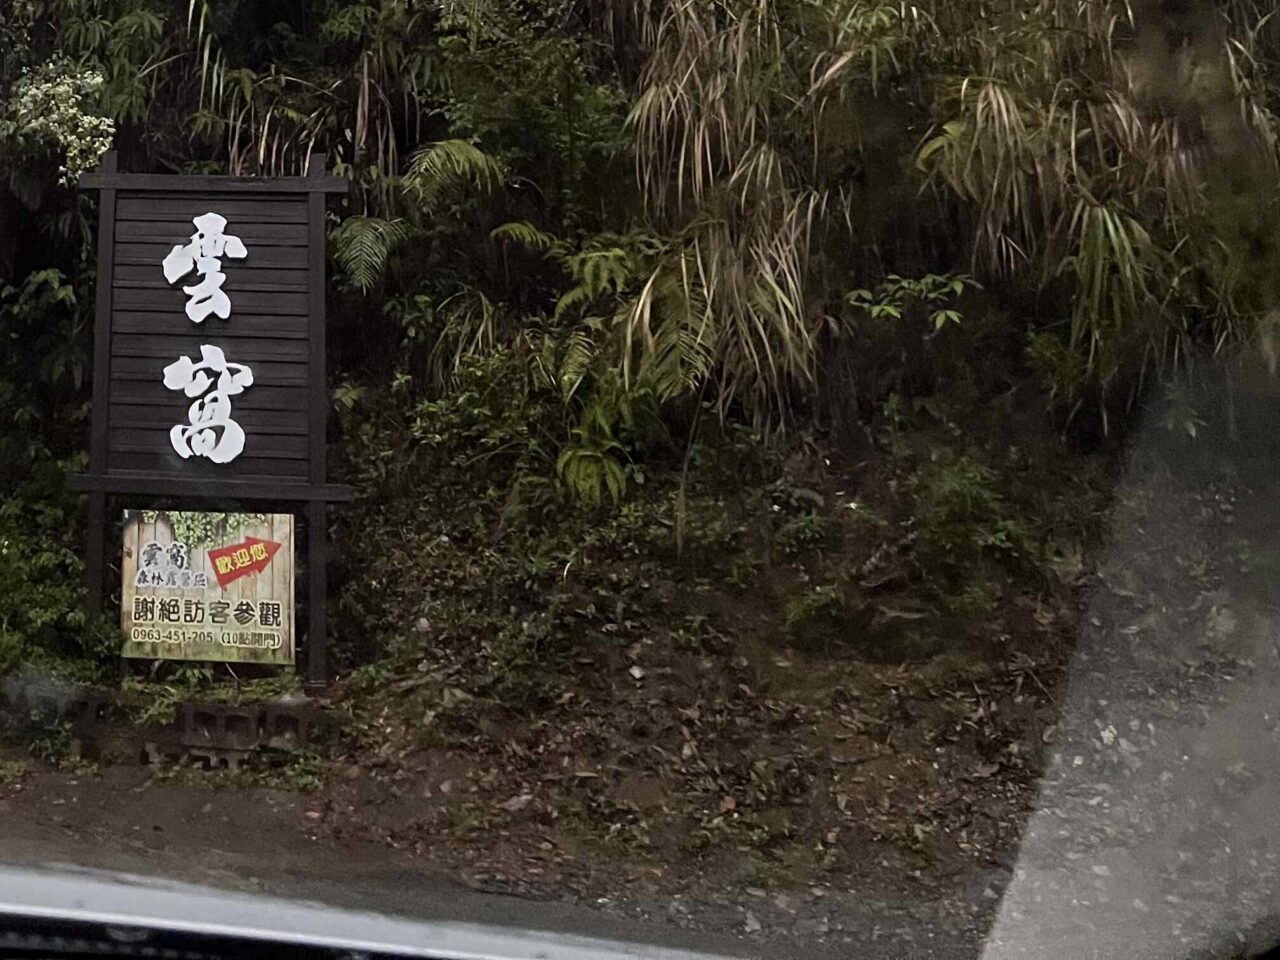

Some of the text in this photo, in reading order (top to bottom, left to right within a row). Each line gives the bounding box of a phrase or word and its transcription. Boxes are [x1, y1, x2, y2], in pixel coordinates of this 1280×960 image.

[162, 212, 254, 463] 雲窩
[215, 543, 268, 575] 歡迎您
[133, 596, 282, 627] 謝絕訪客參觀
[132, 628, 214, 643] 0963-451-205
